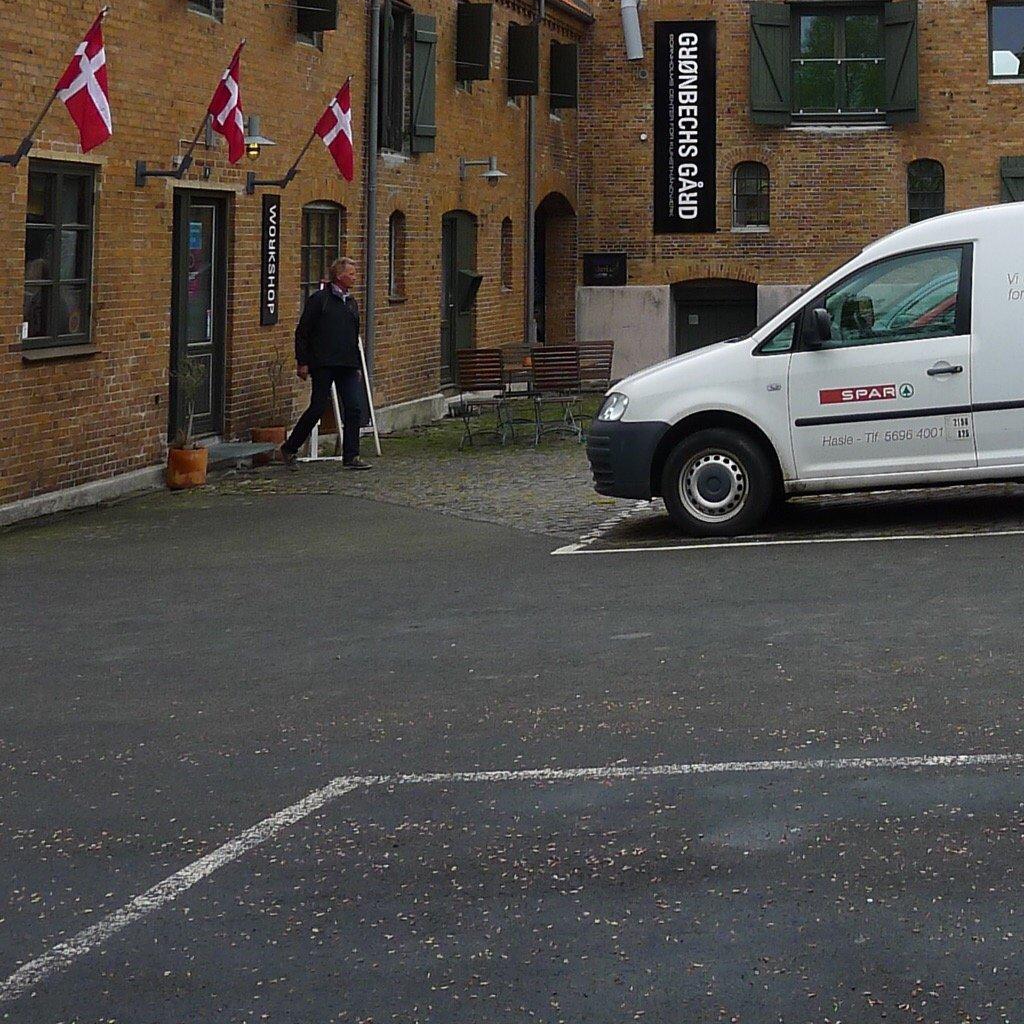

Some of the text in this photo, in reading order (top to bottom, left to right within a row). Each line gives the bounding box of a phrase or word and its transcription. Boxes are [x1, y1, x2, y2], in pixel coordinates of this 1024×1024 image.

[678, 32, 704, 220] GRØNBECHS GÅRD
[267, 205, 277, 314] WORKSHOP
[1007, 272, 1020, 285] Vi
[841, 386, 896, 401] SPAR
[822, 434, 854, 447] Hasle
[915, 427, 943, 439] 4001
